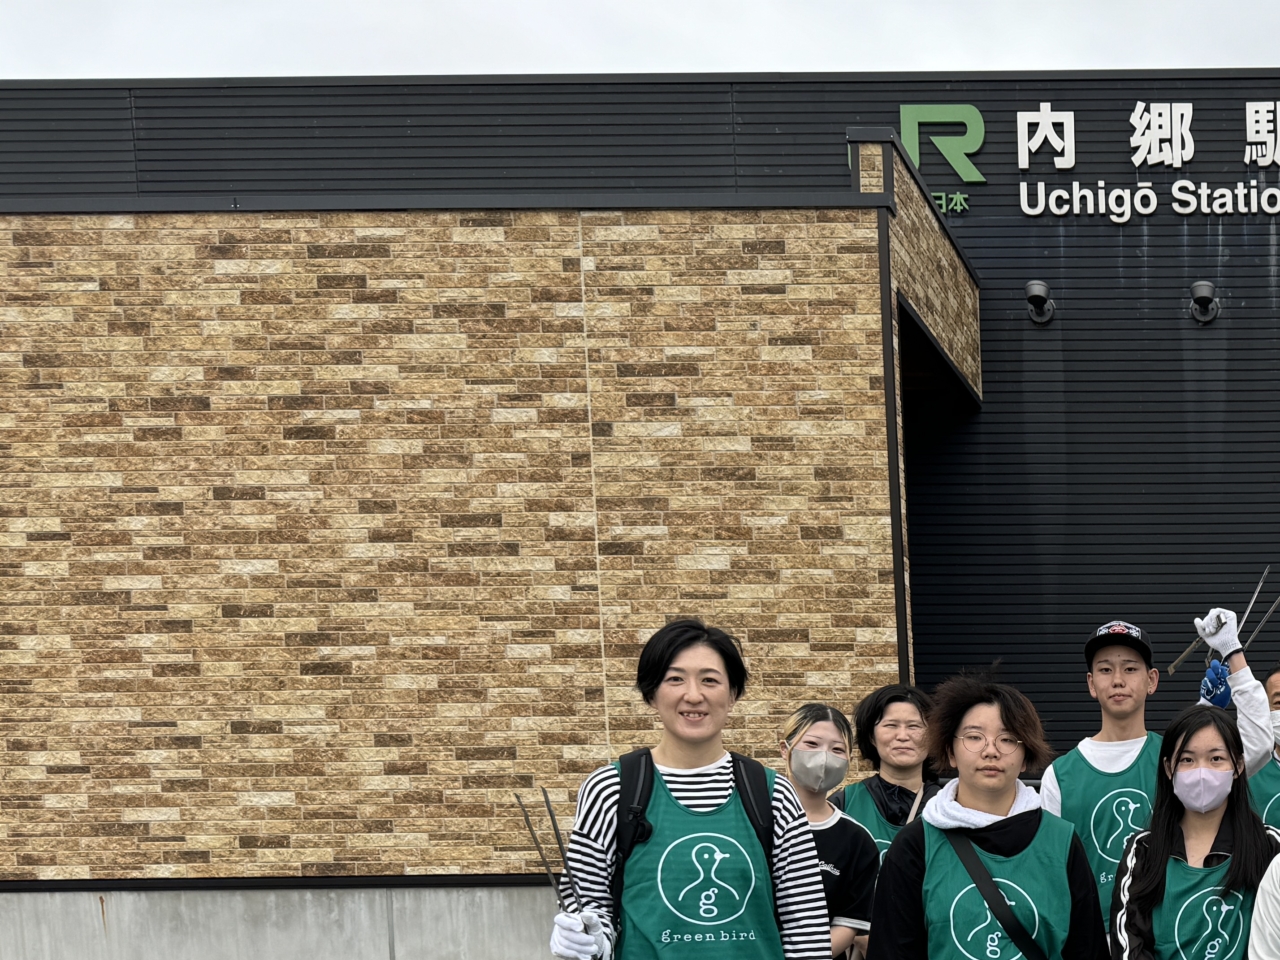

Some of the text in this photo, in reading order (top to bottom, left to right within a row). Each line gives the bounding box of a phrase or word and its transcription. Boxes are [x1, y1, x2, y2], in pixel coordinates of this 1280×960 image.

[1020, 180, 1158, 223] Uchigō
[699, 887, 718, 917] g
[661, 929, 756, 943] green bird
[986, 931, 1002, 958] g
